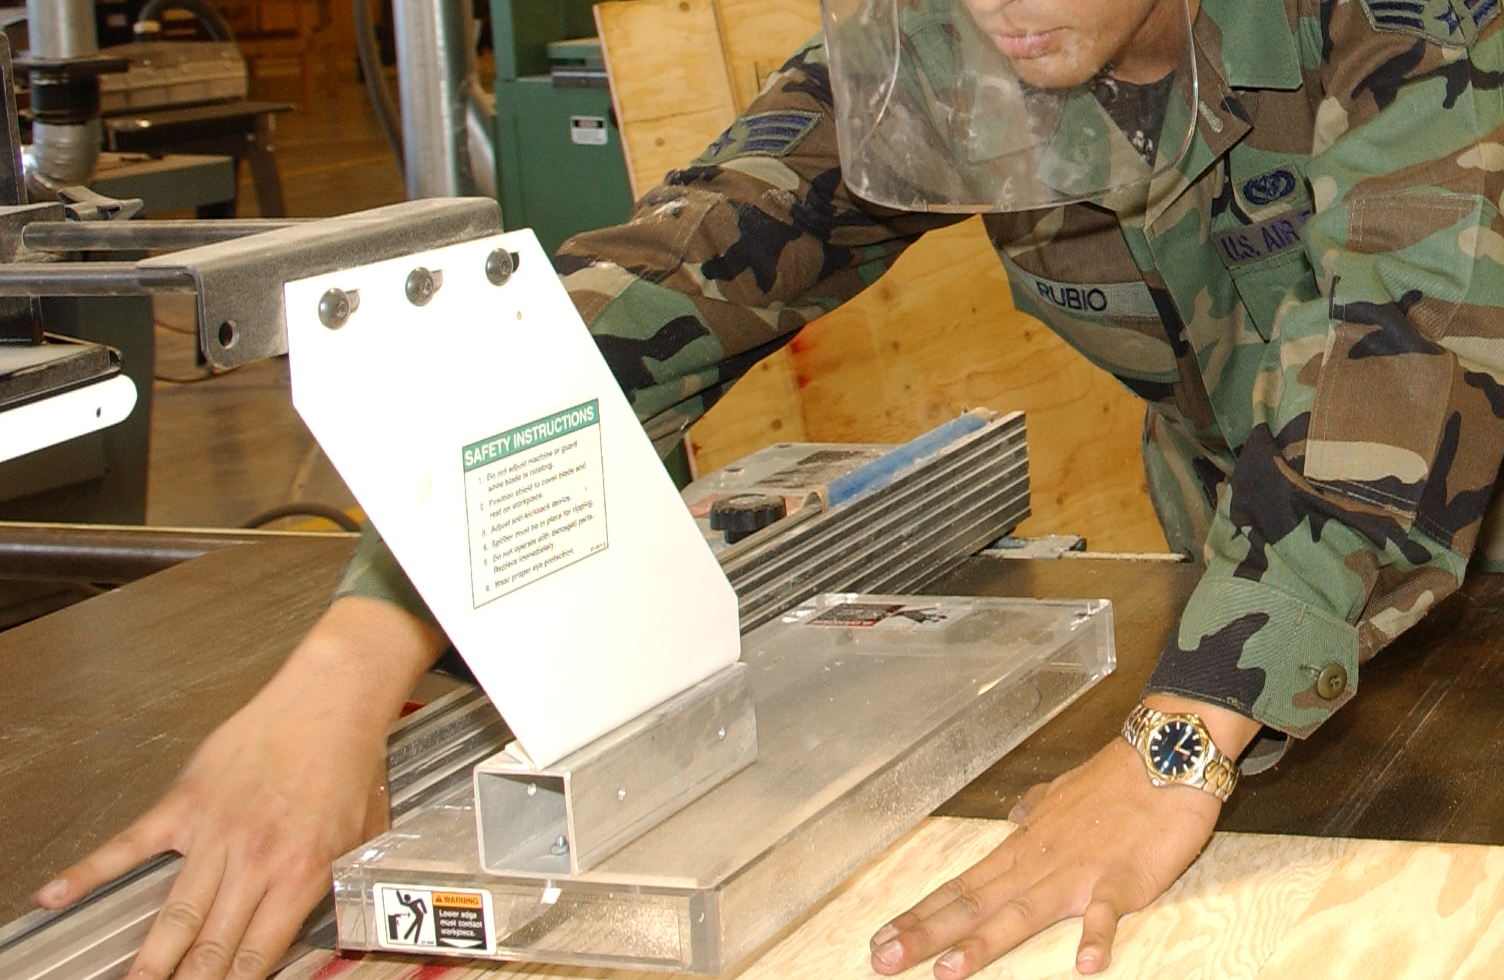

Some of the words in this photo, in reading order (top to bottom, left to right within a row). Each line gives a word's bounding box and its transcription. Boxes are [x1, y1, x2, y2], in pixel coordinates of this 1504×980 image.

[1221, 234, 1260, 262] U.S.
[1264, 219, 1300, 252] AIR
[1036, 280, 1108, 312] RUBIO
[464, 438, 511, 467] SAFETY
[513, 405, 595, 448] INSTRUCTIONS
[443, 895, 479, 906] WARNING
